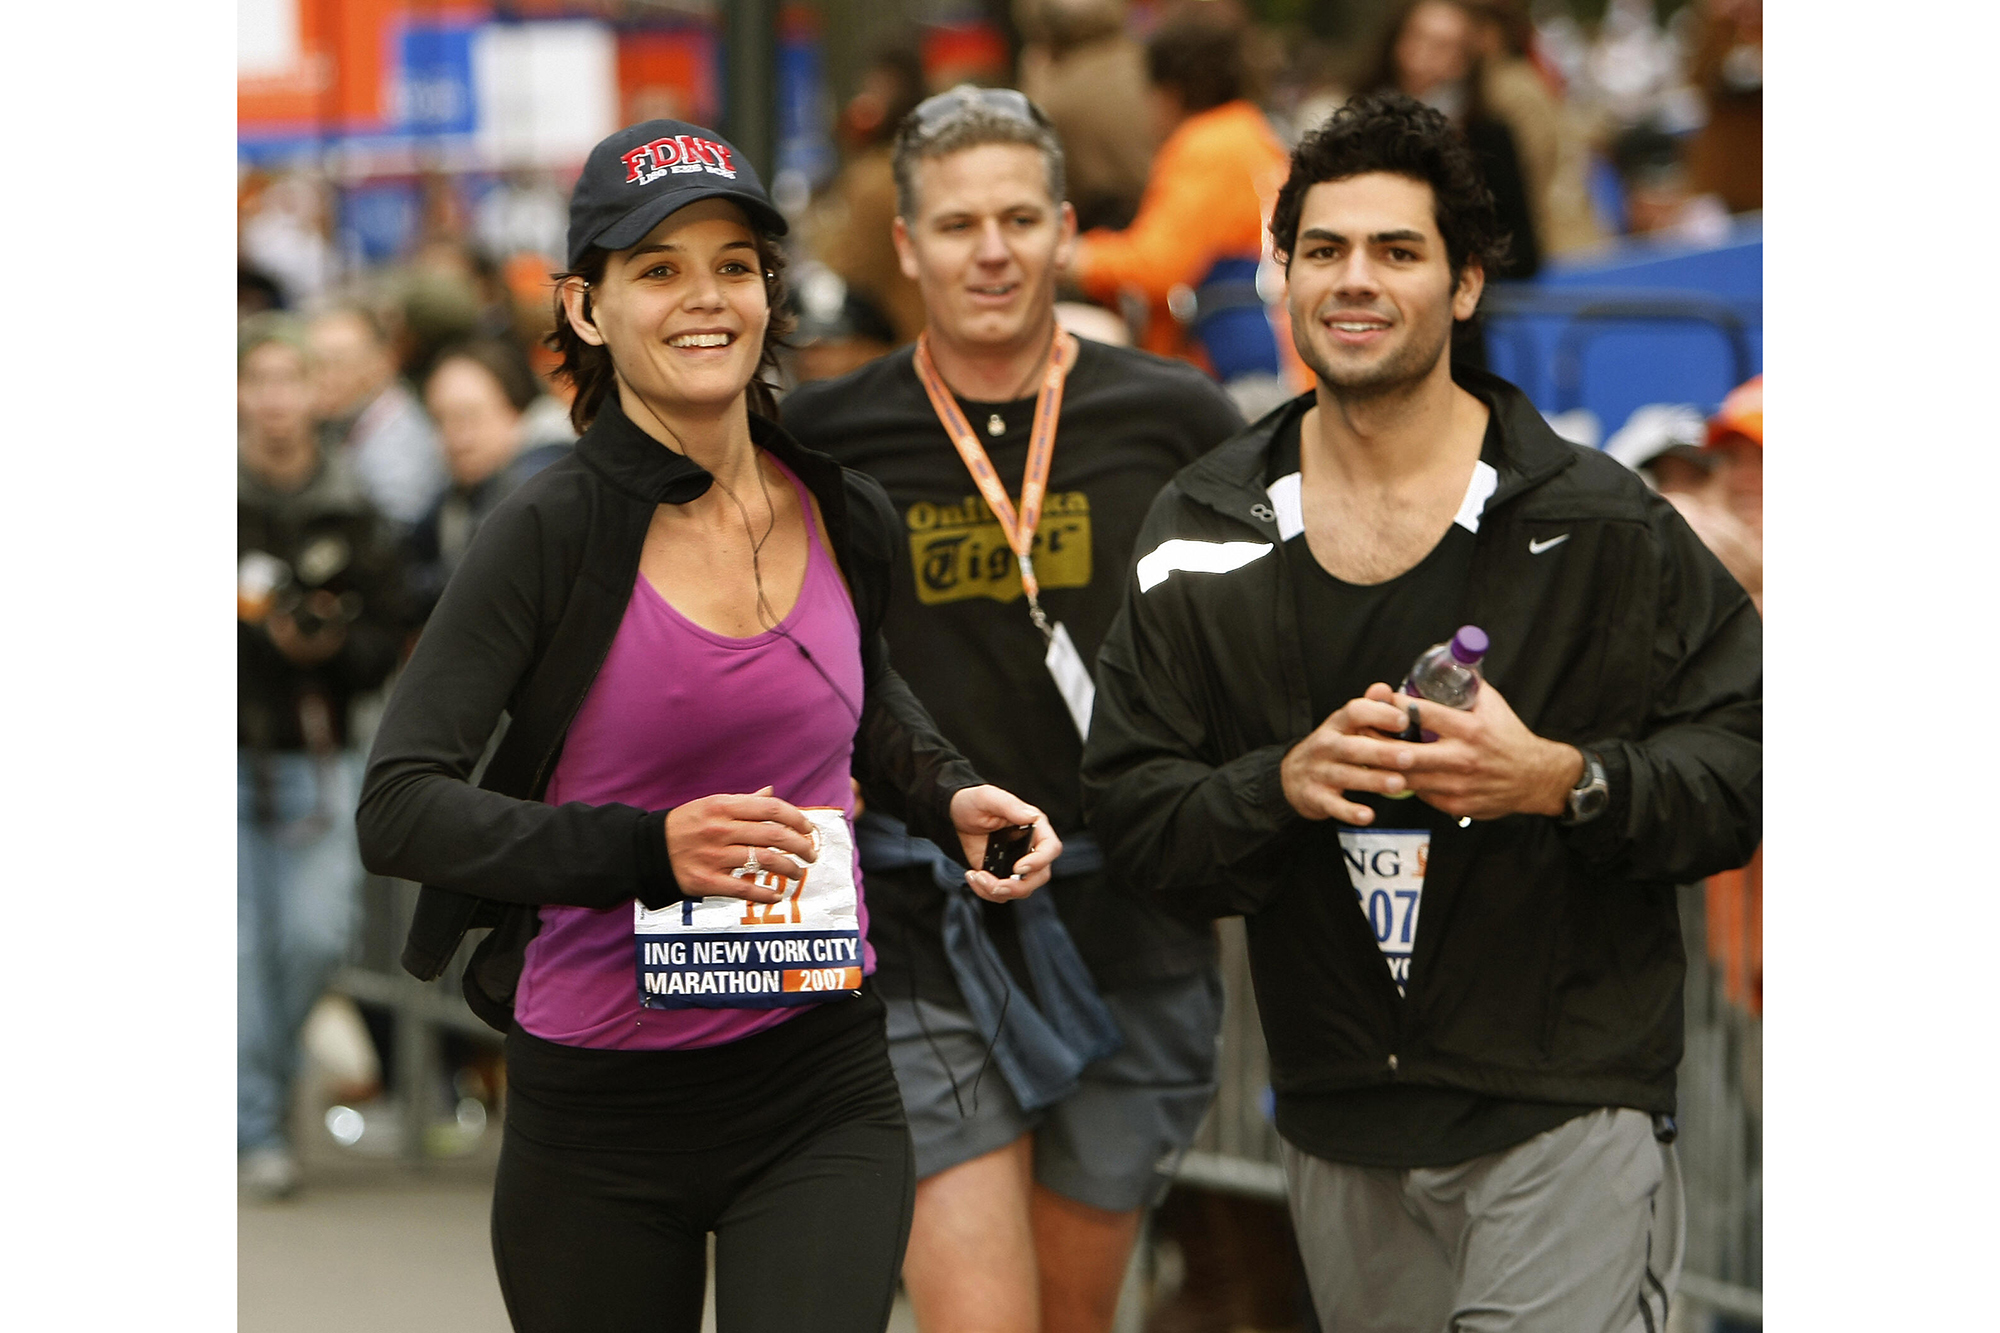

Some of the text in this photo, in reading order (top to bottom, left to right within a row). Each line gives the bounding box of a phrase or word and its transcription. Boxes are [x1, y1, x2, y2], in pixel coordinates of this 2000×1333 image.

[620, 134, 737, 183] FDNY
[923, 524, 1080, 592] Tigr
[1341, 848, 1401, 878] NG
[1354, 888, 1418, 943] 07
[644, 937, 858, 966] ING NEW YORK CITY
[644, 967, 846, 995] MARATHON 2007
